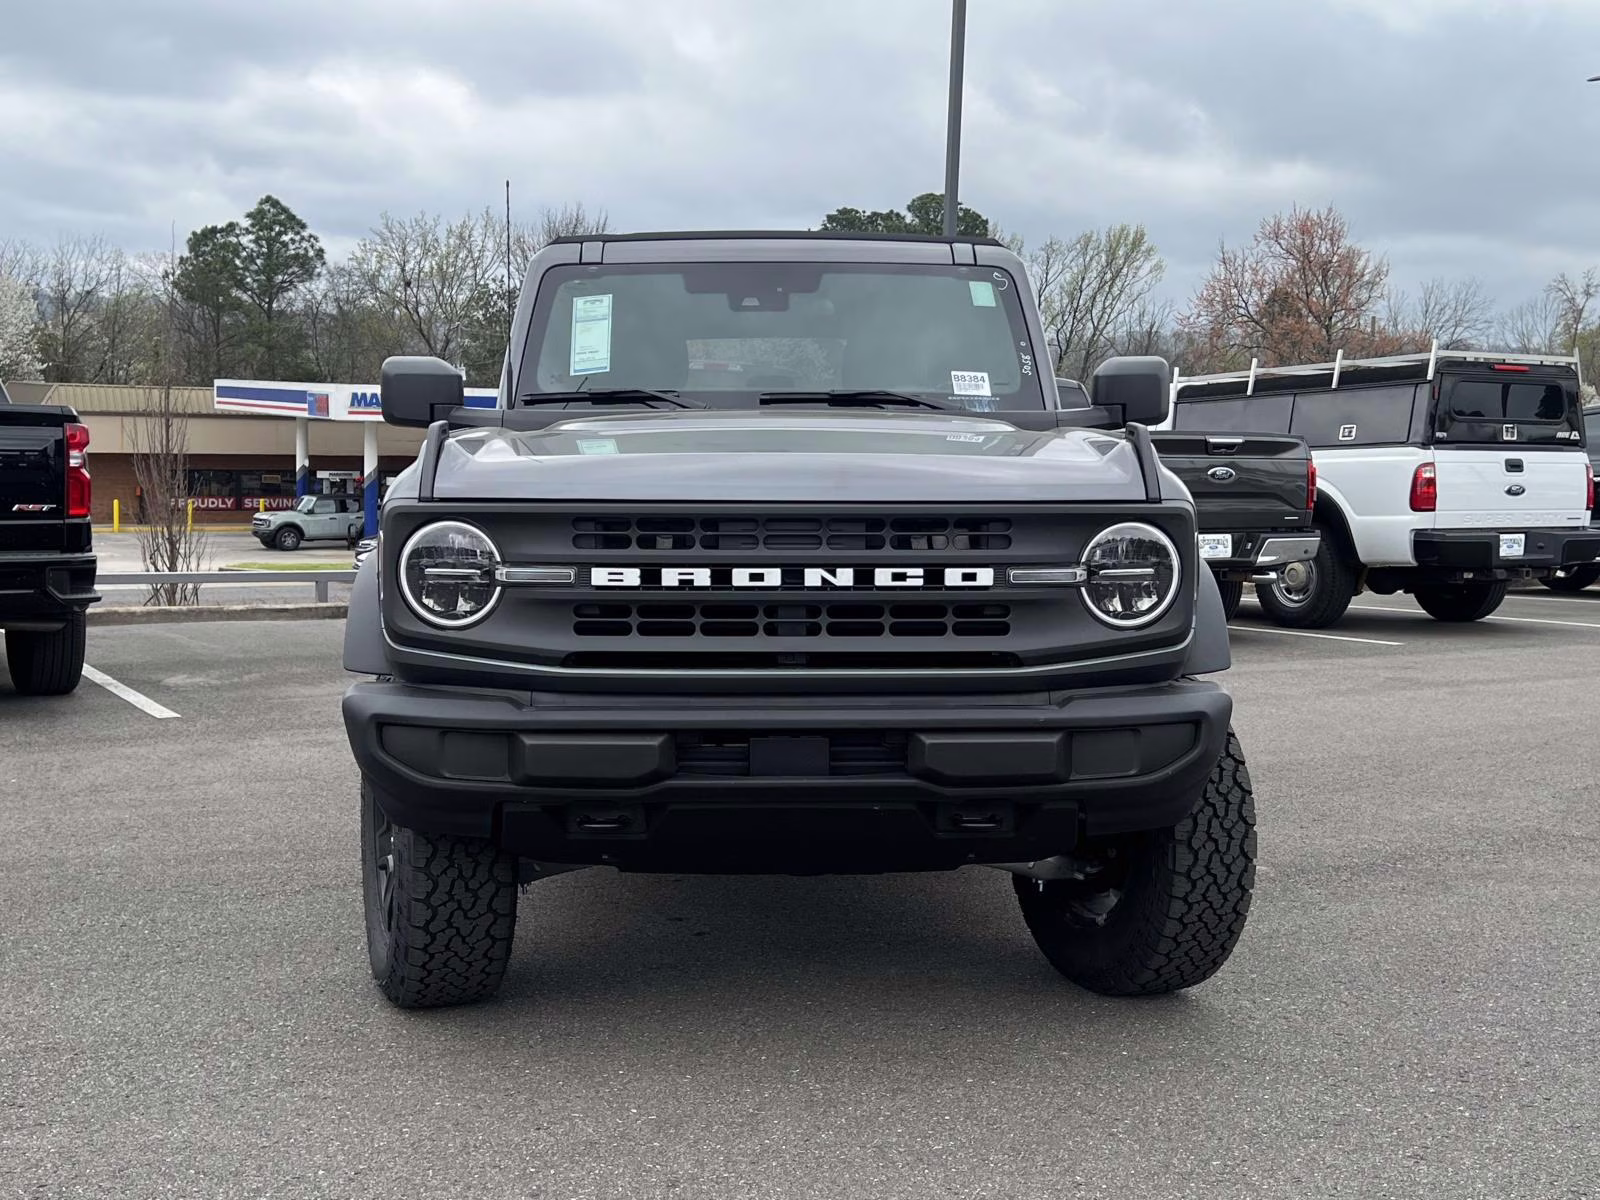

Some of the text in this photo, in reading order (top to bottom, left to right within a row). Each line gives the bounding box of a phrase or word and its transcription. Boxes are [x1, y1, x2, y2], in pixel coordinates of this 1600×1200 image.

[953, 374, 985, 383] B8384
[1463, 513, 1512, 525] SUPER
[591, 567, 994, 586] BRONCO
